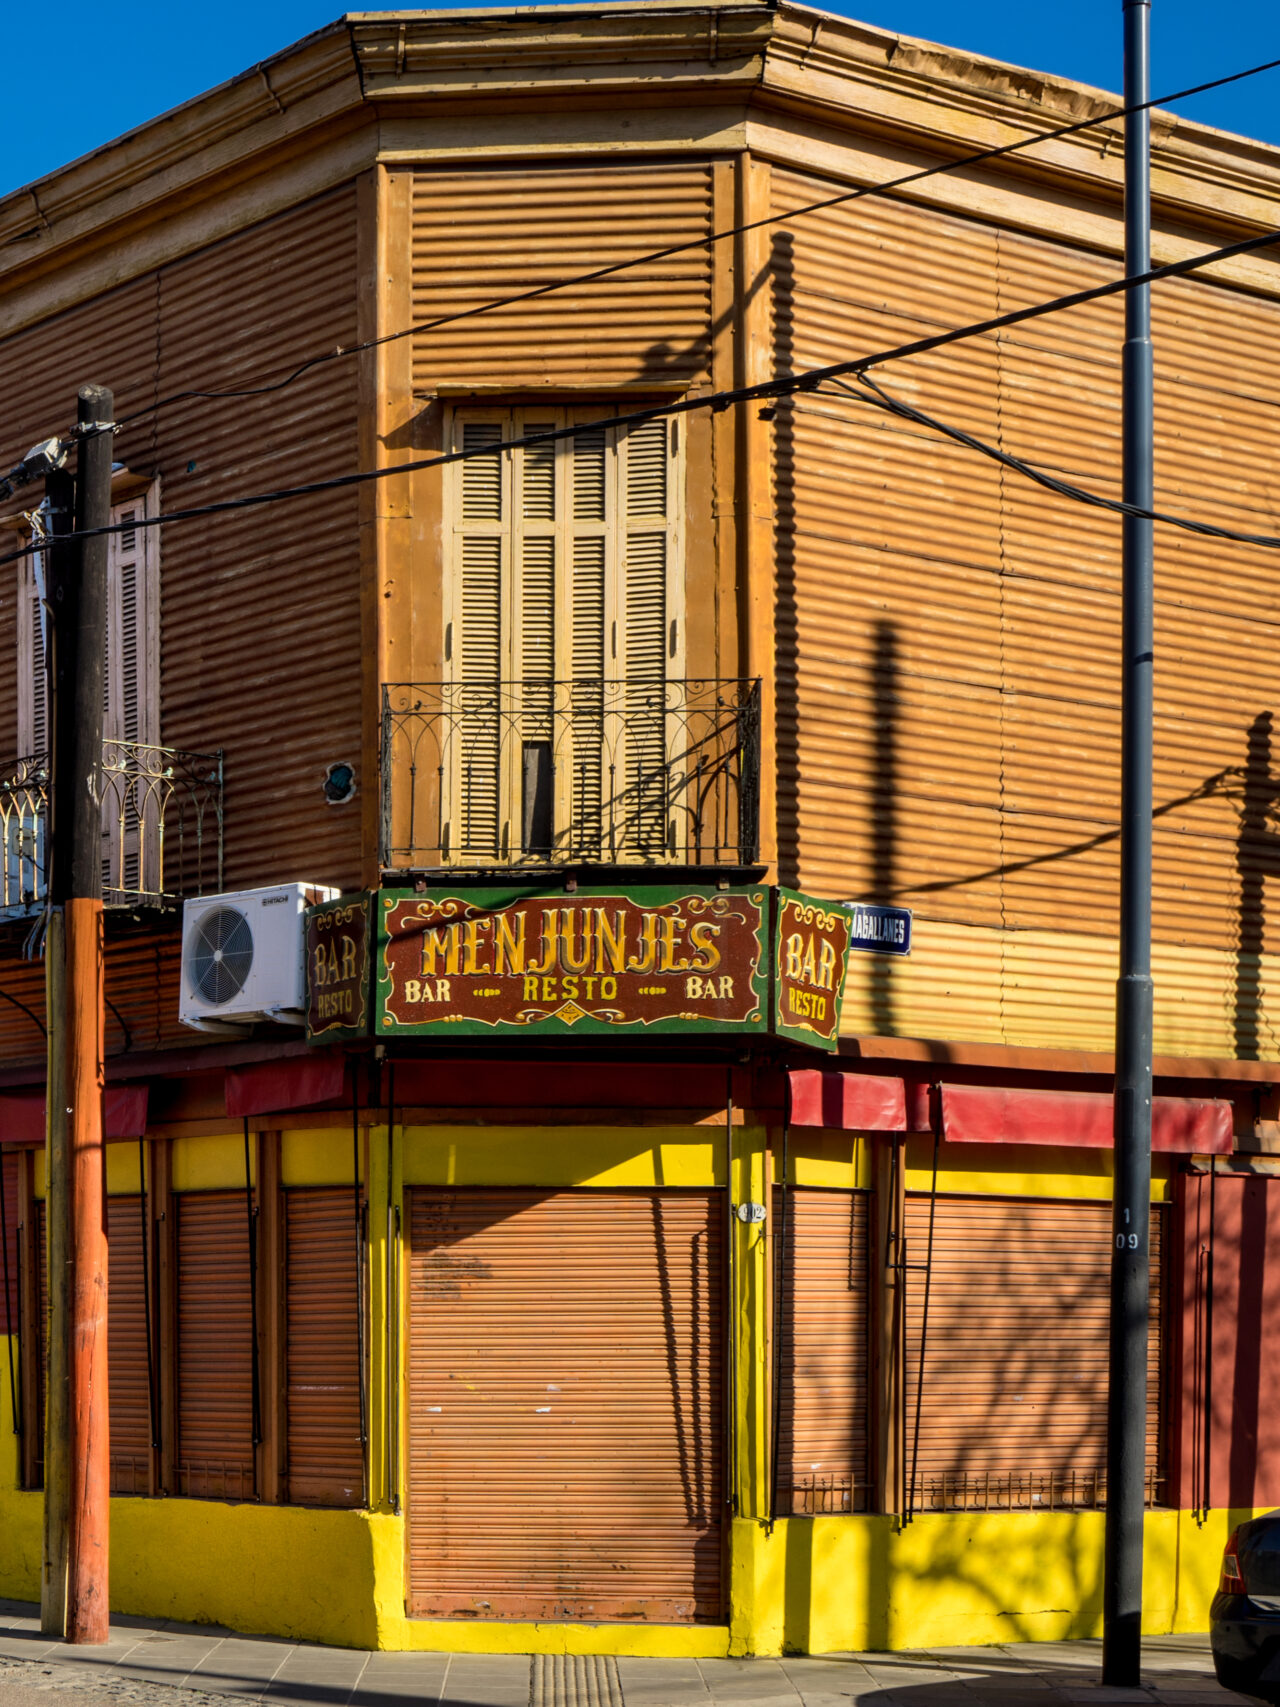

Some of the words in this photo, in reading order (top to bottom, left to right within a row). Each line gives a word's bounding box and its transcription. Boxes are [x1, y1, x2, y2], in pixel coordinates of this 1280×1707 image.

[420, 907, 721, 976] MENJUNJES
[314, 935, 357, 987] BAR
[785, 931, 837, 992] BAR
[318, 989, 353, 1018] RESTO
[405, 979, 451, 1003] BAR
[523, 976, 617, 1001] RESTO
[686, 975, 735, 1000] BAR
[788, 987, 827, 1021] RESTO
[743, 1206, 762, 1219] 902
[1123, 1207, 1130, 1224] 1
[1116, 1233, 1139, 1249] 09
